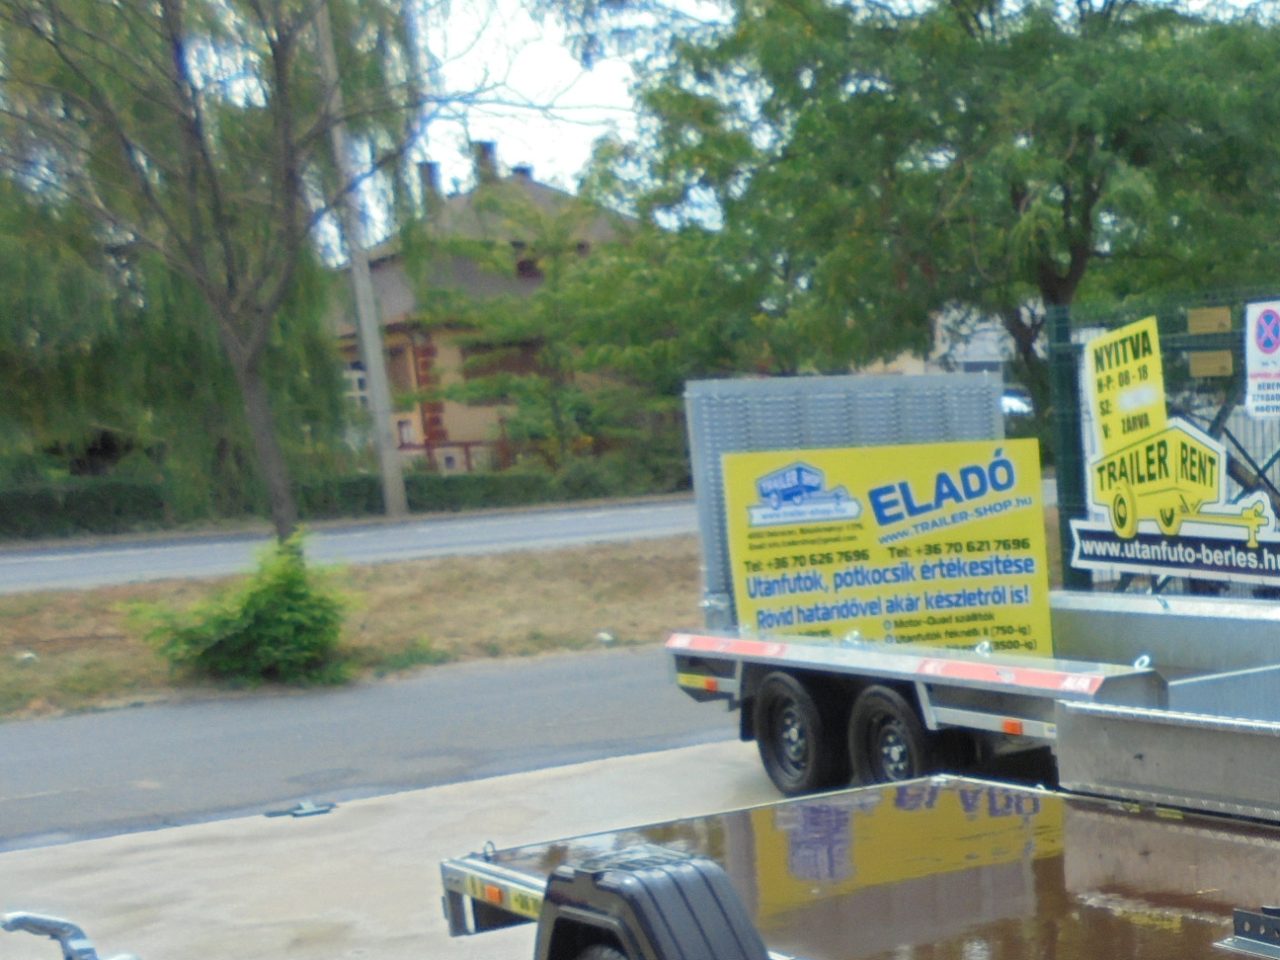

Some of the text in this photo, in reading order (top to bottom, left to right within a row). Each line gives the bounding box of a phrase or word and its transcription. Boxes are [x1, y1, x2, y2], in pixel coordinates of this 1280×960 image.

[1094, 330, 1153, 374] NYITVA
[868, 447, 1015, 527] ELADÓ
[1097, 440, 1217, 491] TRAILER RENT
[792, 555, 807, 568] 70
[836, 549, 870, 563] 7696
[945, 542, 963, 553] 70
[967, 540, 991, 552] 621
[994, 538, 1031, 551] 7696
